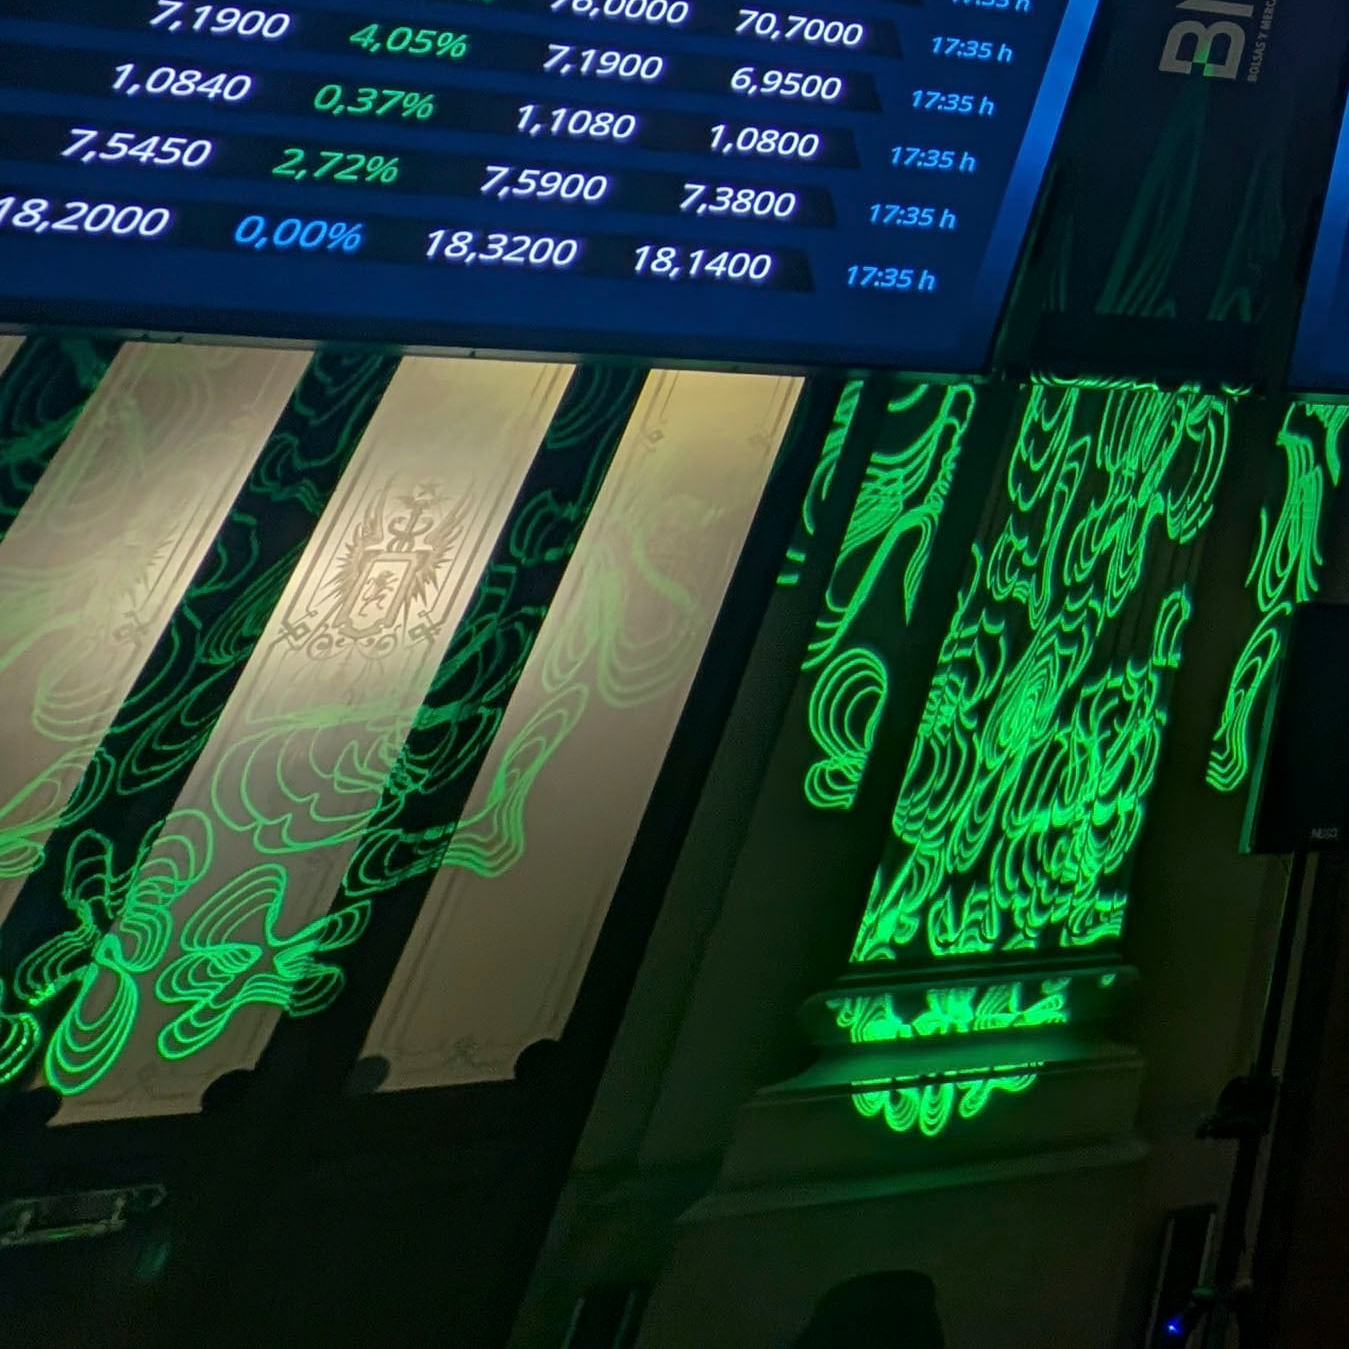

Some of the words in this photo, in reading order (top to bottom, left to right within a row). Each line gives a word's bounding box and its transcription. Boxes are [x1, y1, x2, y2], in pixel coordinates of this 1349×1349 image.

[736, 10, 863, 45] 70,7000
[0, 197, 169, 235] 18,2000
[235, 216, 362, 251] 0,00%
[427, 230, 577, 265] 18,3200
[635, 246, 771, 279] 18,1400
[848, 266, 912, 289] 17:35
[918, 270, 935, 290] h
